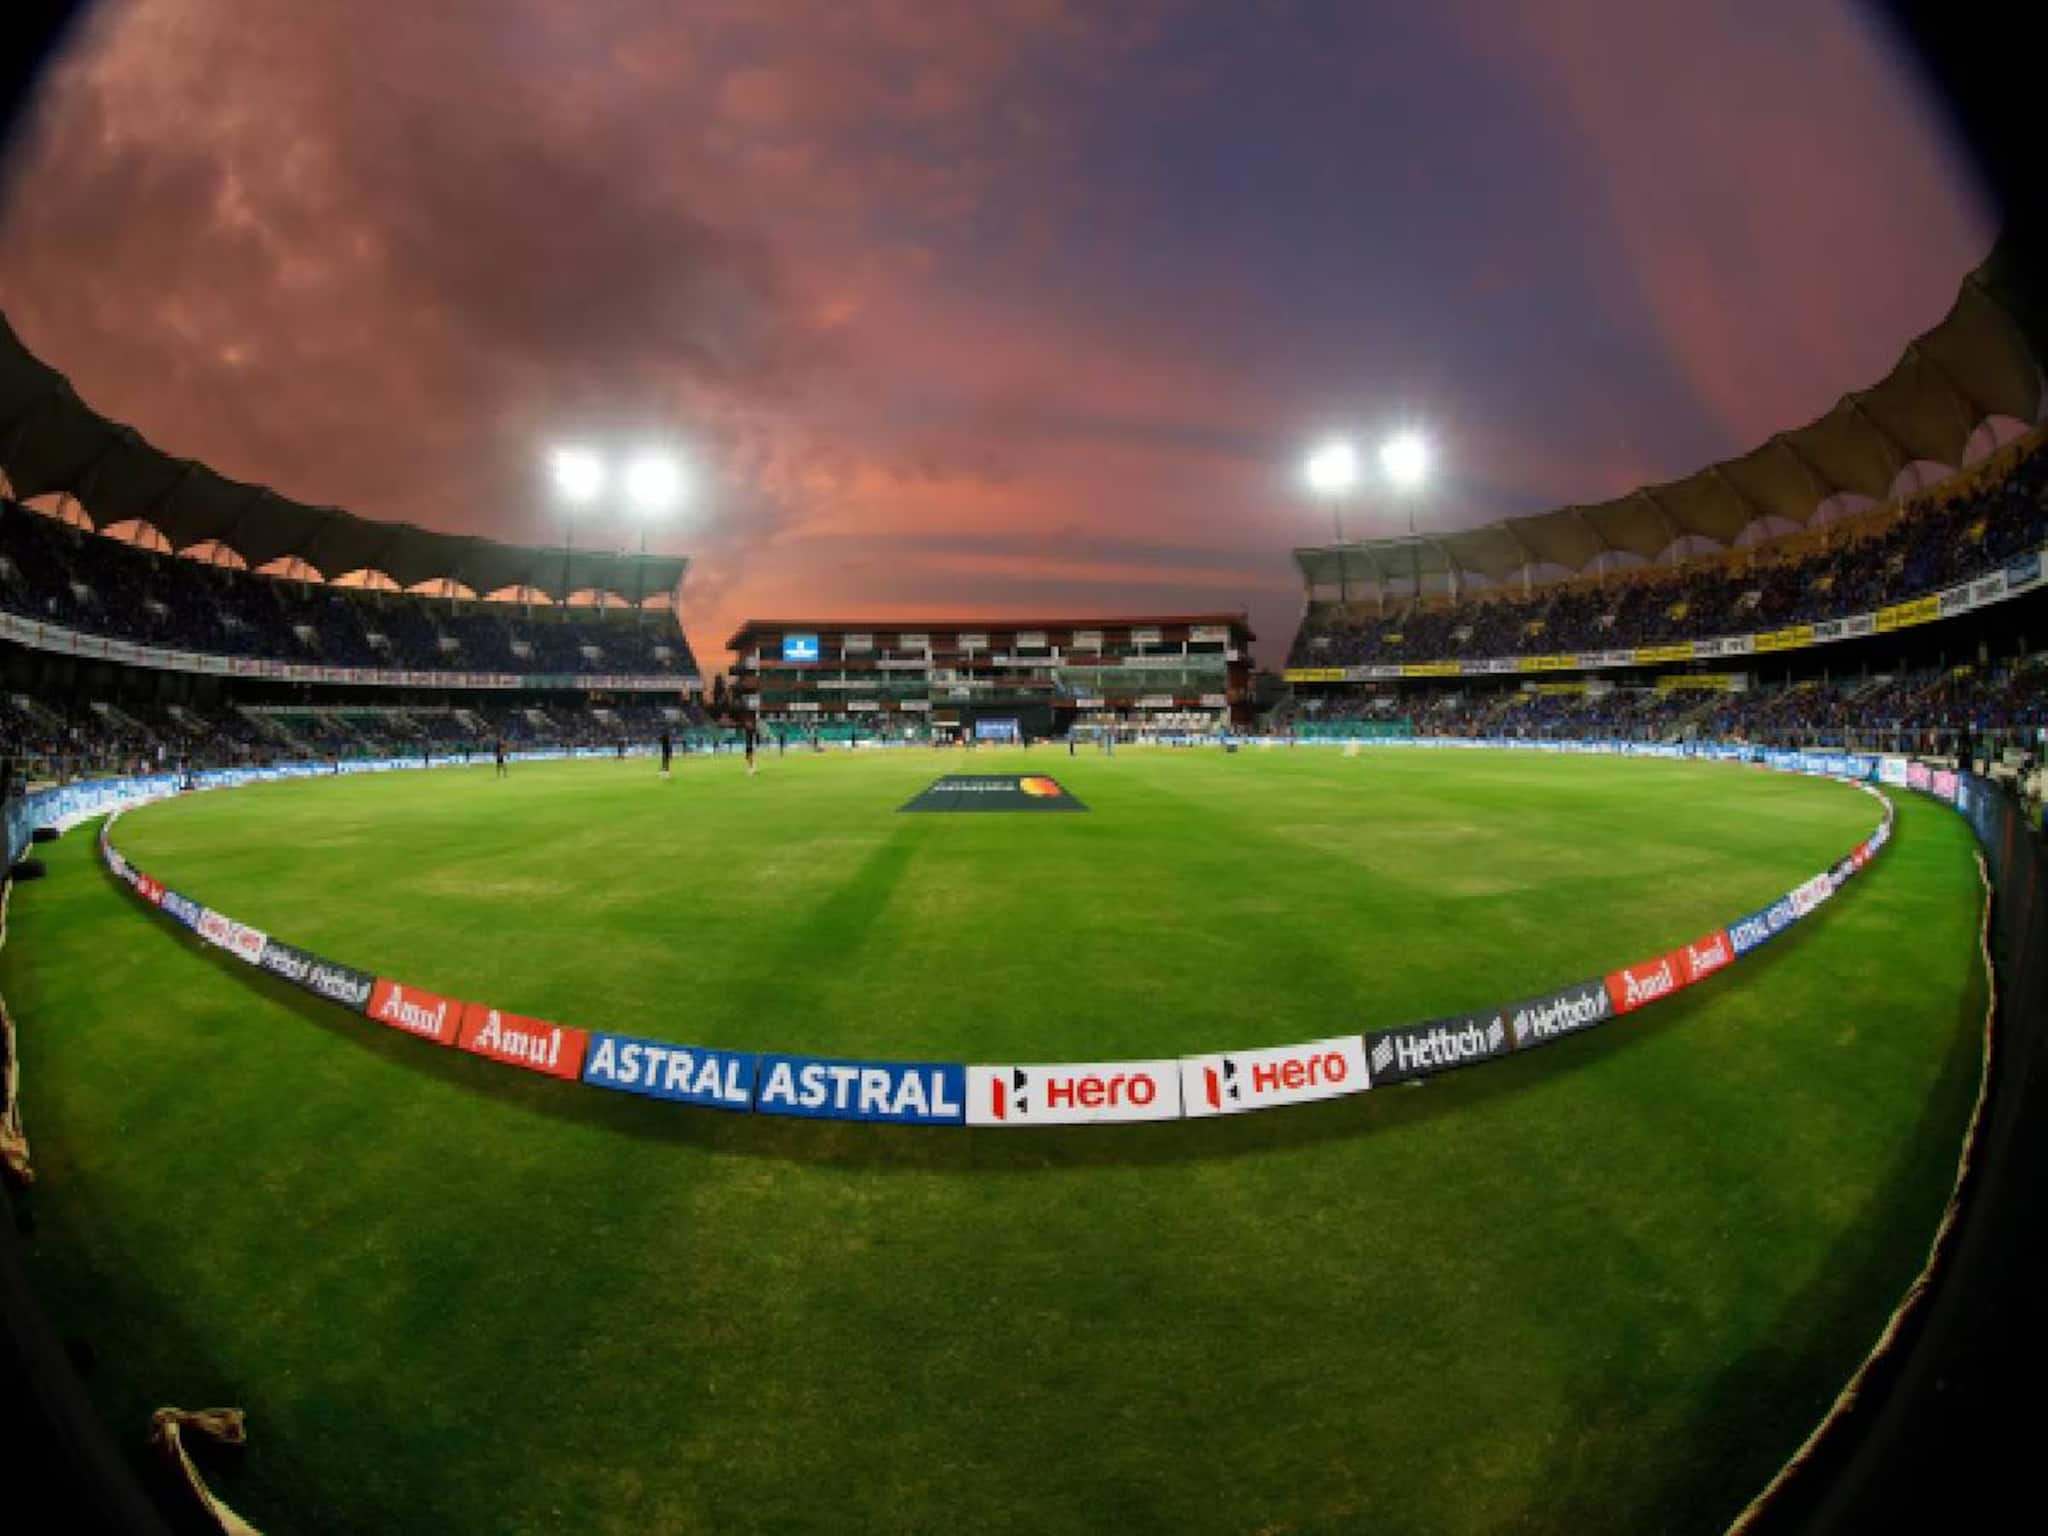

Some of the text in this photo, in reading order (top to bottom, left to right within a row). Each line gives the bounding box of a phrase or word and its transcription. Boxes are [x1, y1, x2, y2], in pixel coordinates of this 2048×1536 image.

[380, 983, 447, 1035] Amul
[474, 1008, 563, 1068] Amul
[589, 1038, 749, 1102] ASTRAL
[762, 1062, 961, 1117] ASTRAL
[1046, 1074, 1157, 1109] Hero
[1252, 1051, 1348, 1093] Hero
